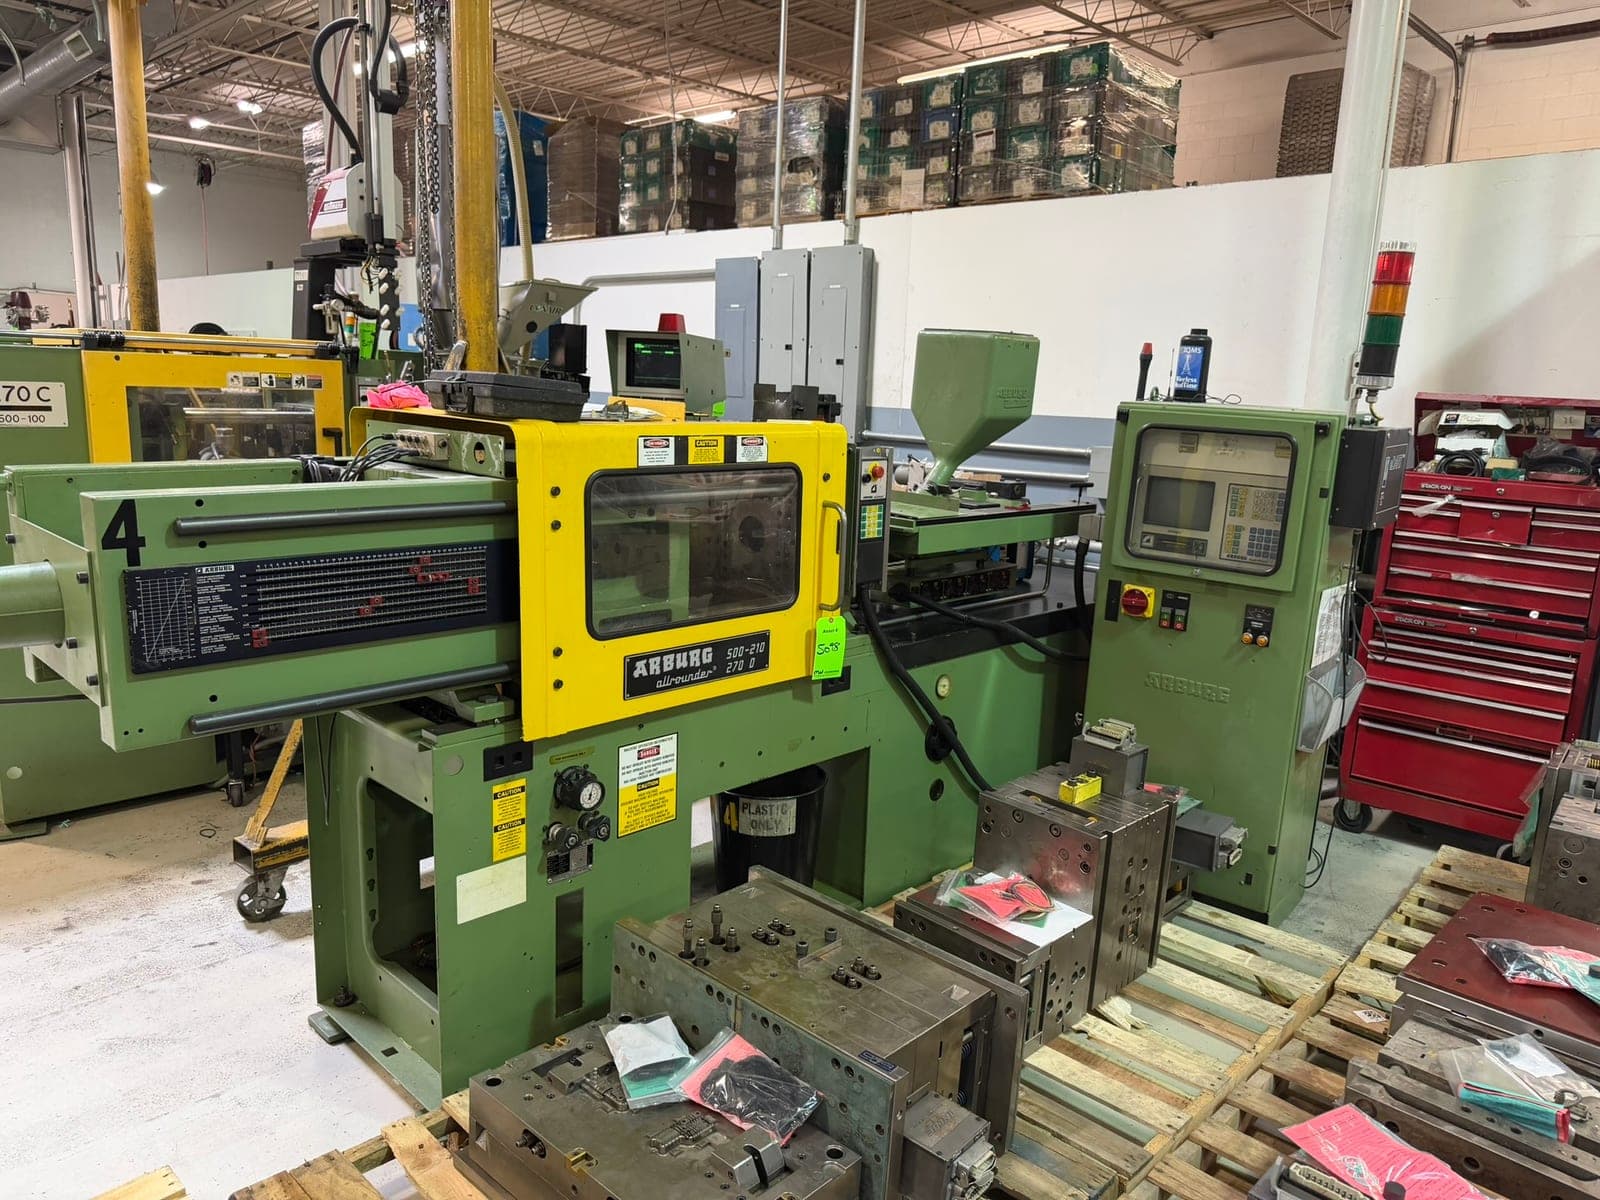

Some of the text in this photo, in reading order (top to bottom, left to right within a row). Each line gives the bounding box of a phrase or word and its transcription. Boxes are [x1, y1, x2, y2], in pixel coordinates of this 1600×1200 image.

[0, 385, 51, 402] 70 C
[101, 498, 146, 567] 4
[632, 641, 766, 678] ARBURG 500-210
[726, 659, 744, 673] 270
[1144, 671, 1231, 704] ARBURG
[497, 787, 522, 798] CAUTION
[723, 802, 739, 832] 4
[742, 802, 788, 817] PLASTIC
[497, 820, 522, 831] CAUTION
[751, 819, 782, 832] ONLY
